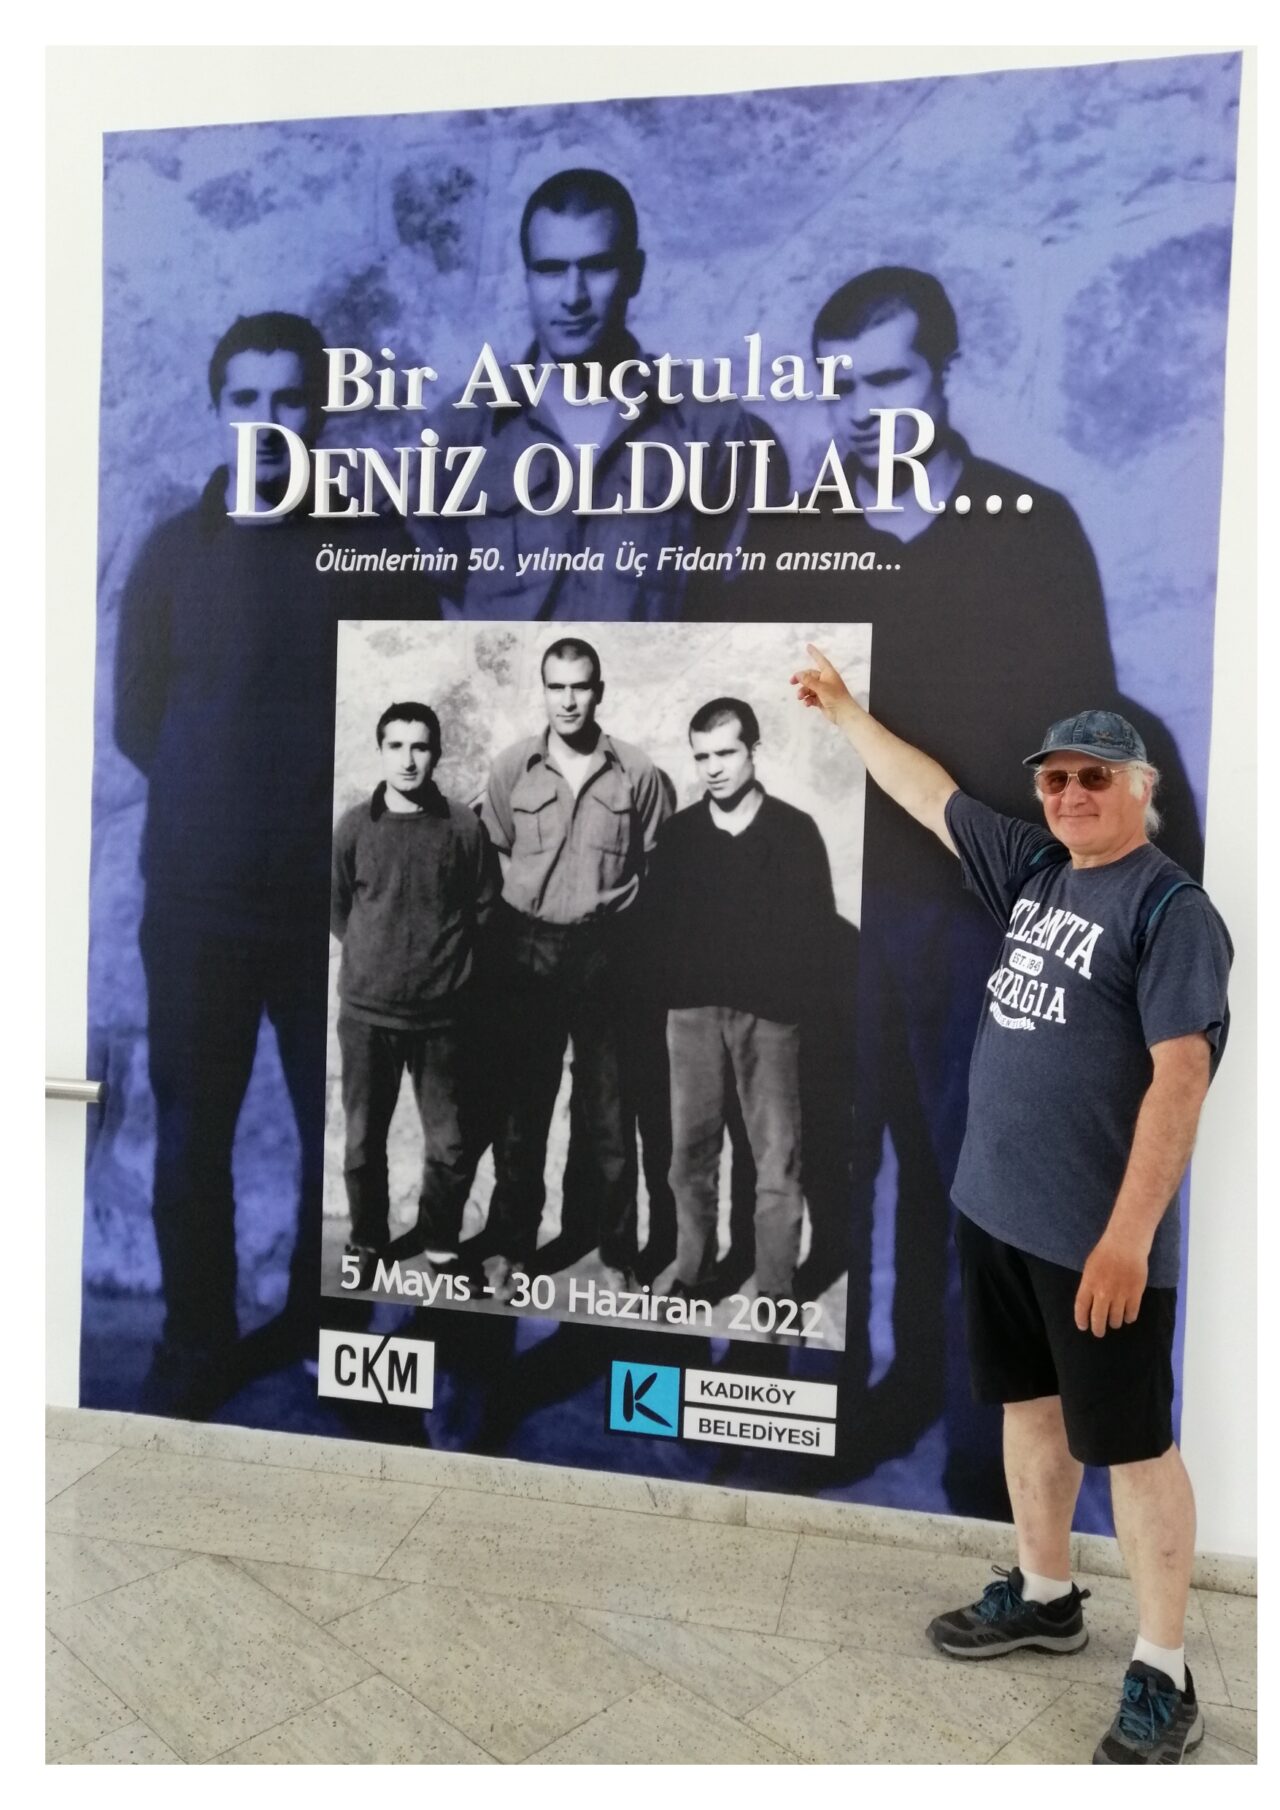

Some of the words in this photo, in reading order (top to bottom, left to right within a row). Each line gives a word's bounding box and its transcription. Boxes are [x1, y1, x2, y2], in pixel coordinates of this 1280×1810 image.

[321, 346, 437, 413] Bir
[453, 332, 853, 421] Avuçtular
[227, 420, 489, 520] DENİZ
[512, 406, 1035, 518] OLDULAR...
[316, 543, 457, 572] Ölümlerinin
[468, 547, 504, 572] 50.
[518, 546, 604, 576] yılında
[615, 540, 648, 578] Üç
[776, 551, 900, 571] anısına...
[1005, 898, 1104, 980] TLANTA
[340, 1255, 361, 1291] 5
[372, 1259, 471, 1306] Mayıs
[510, 1272, 556, 1309] 30
[569, 1280, 713, 1327] Haziran
[728, 1295, 825, 1338] 2022
[334, 1338, 419, 1402] CKM
[699, 1380, 797, 1407] KADIKÖY
[698, 1417, 822, 1449] BELEDİYESİ
